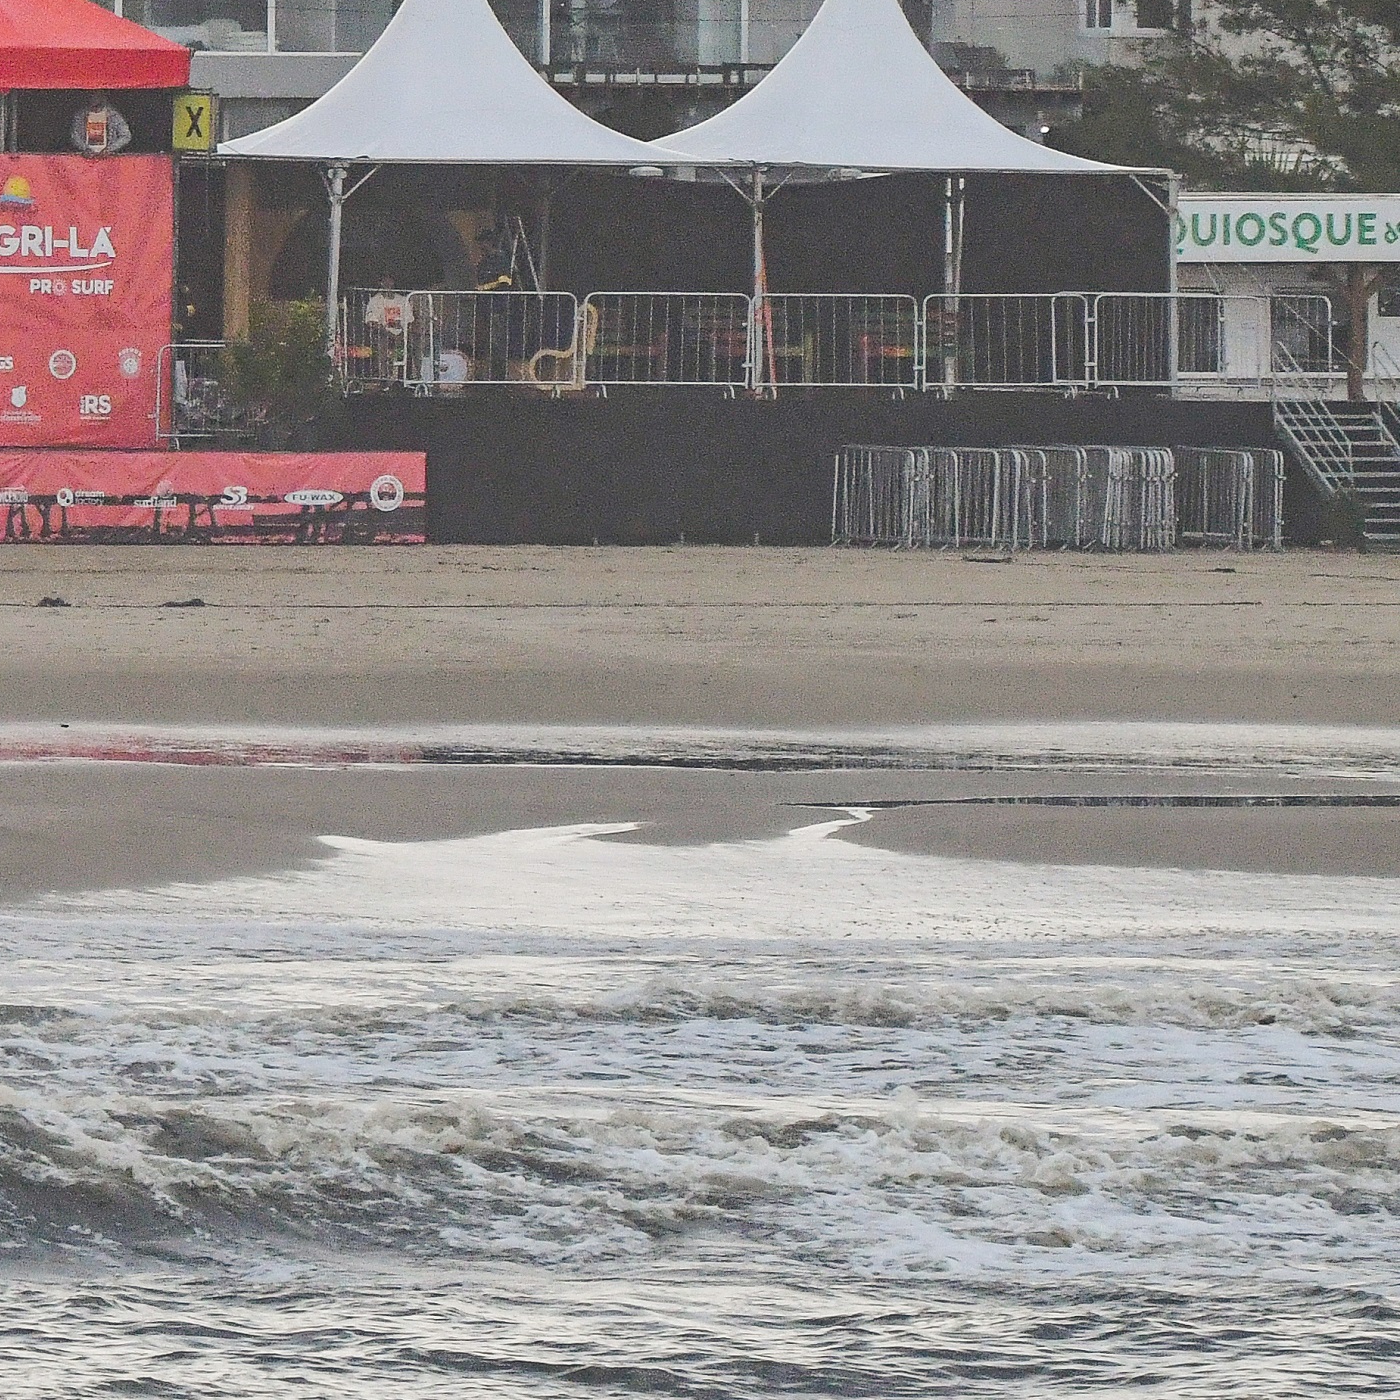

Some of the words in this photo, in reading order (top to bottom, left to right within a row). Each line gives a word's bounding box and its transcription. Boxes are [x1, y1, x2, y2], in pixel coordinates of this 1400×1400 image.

[185, 106, 204, 138] X
[71, 278, 115, 296] SURF
[83, 394, 112, 415] RS
